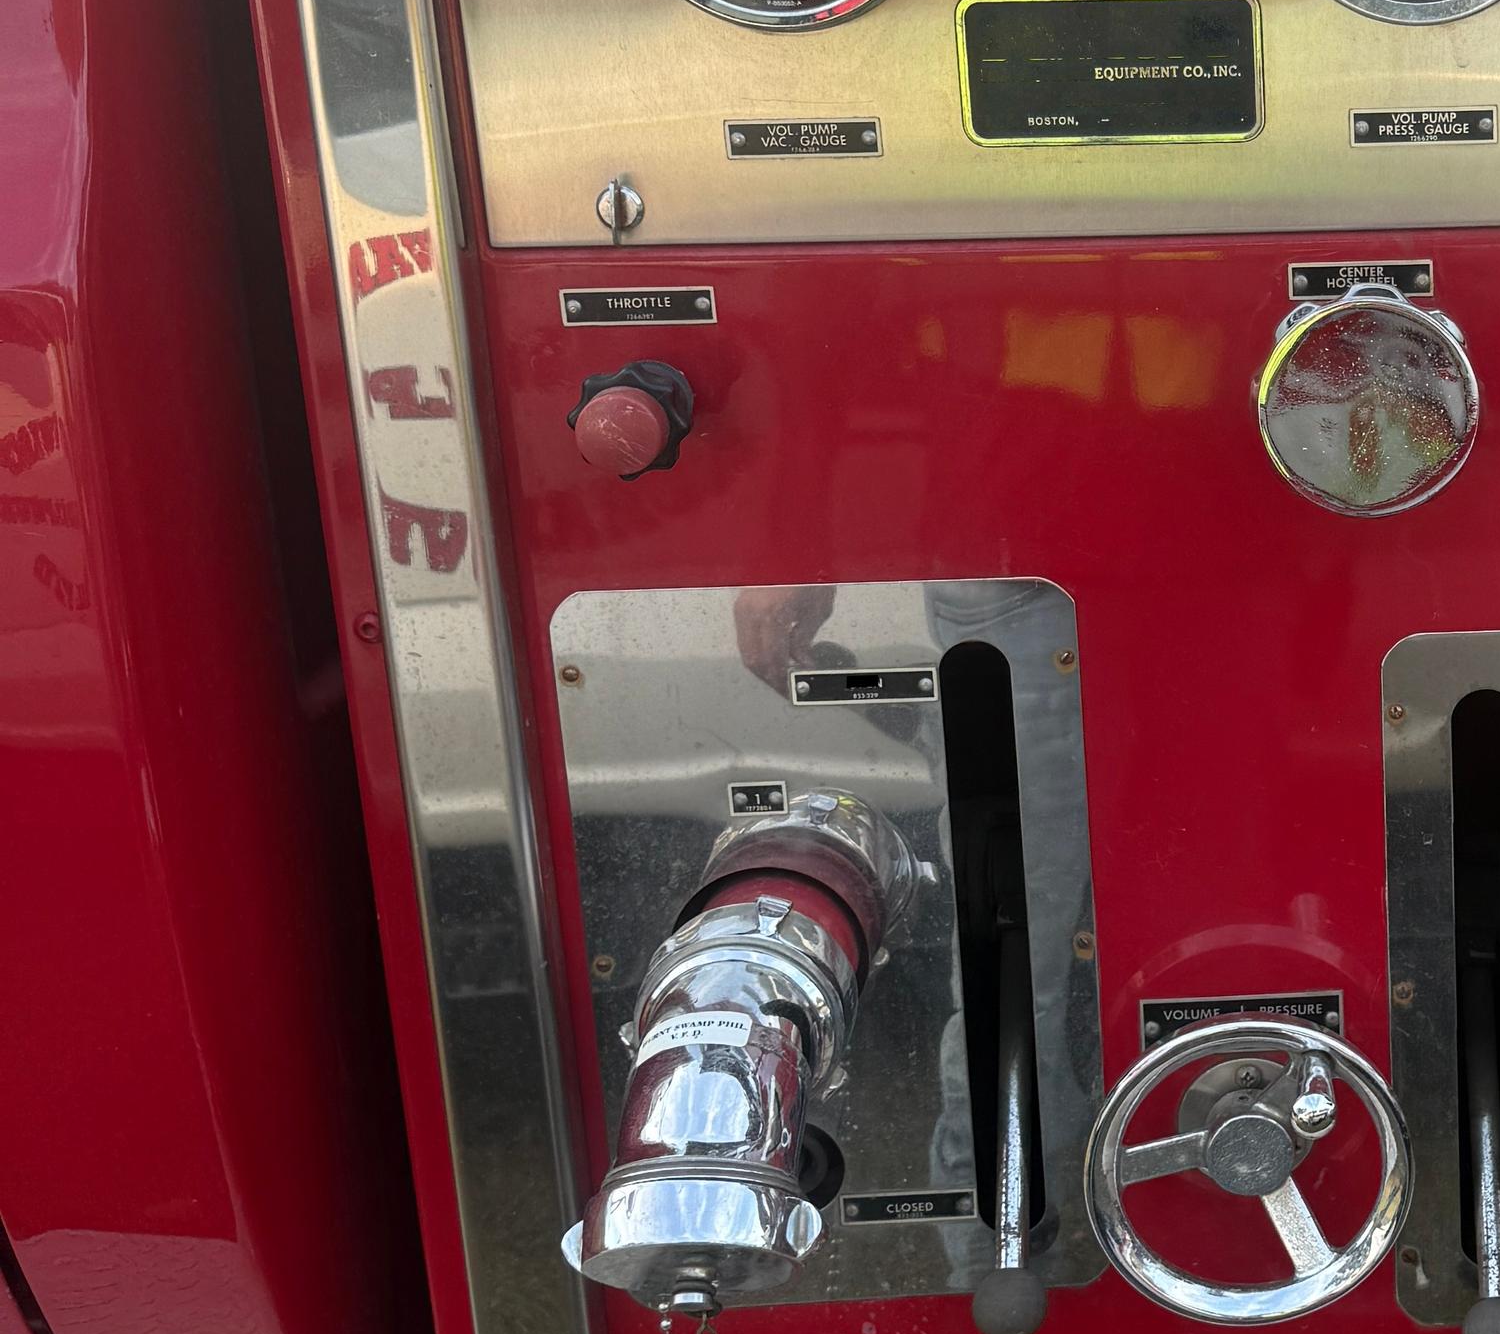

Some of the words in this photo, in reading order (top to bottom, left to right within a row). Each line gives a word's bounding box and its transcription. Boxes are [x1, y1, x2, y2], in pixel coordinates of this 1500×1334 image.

[1094, 67, 1179, 79] EQUIPMENT
[1028, 115, 1079, 127] BOSTON,
[801, 125, 838, 136] PUMP
[1379, 125, 1418, 135] PRESS.
[1425, 123, 1469, 134] GAUGE
[761, 136, 792, 147] VAC.
[800, 135, 848, 147] GAUGE
[1339, 267, 1384, 277] CENTER
[607, 297, 671, 309] THROTTLE
[755, 794, 760, 805] 1
[887, 1202, 934, 1213] CLOSED
